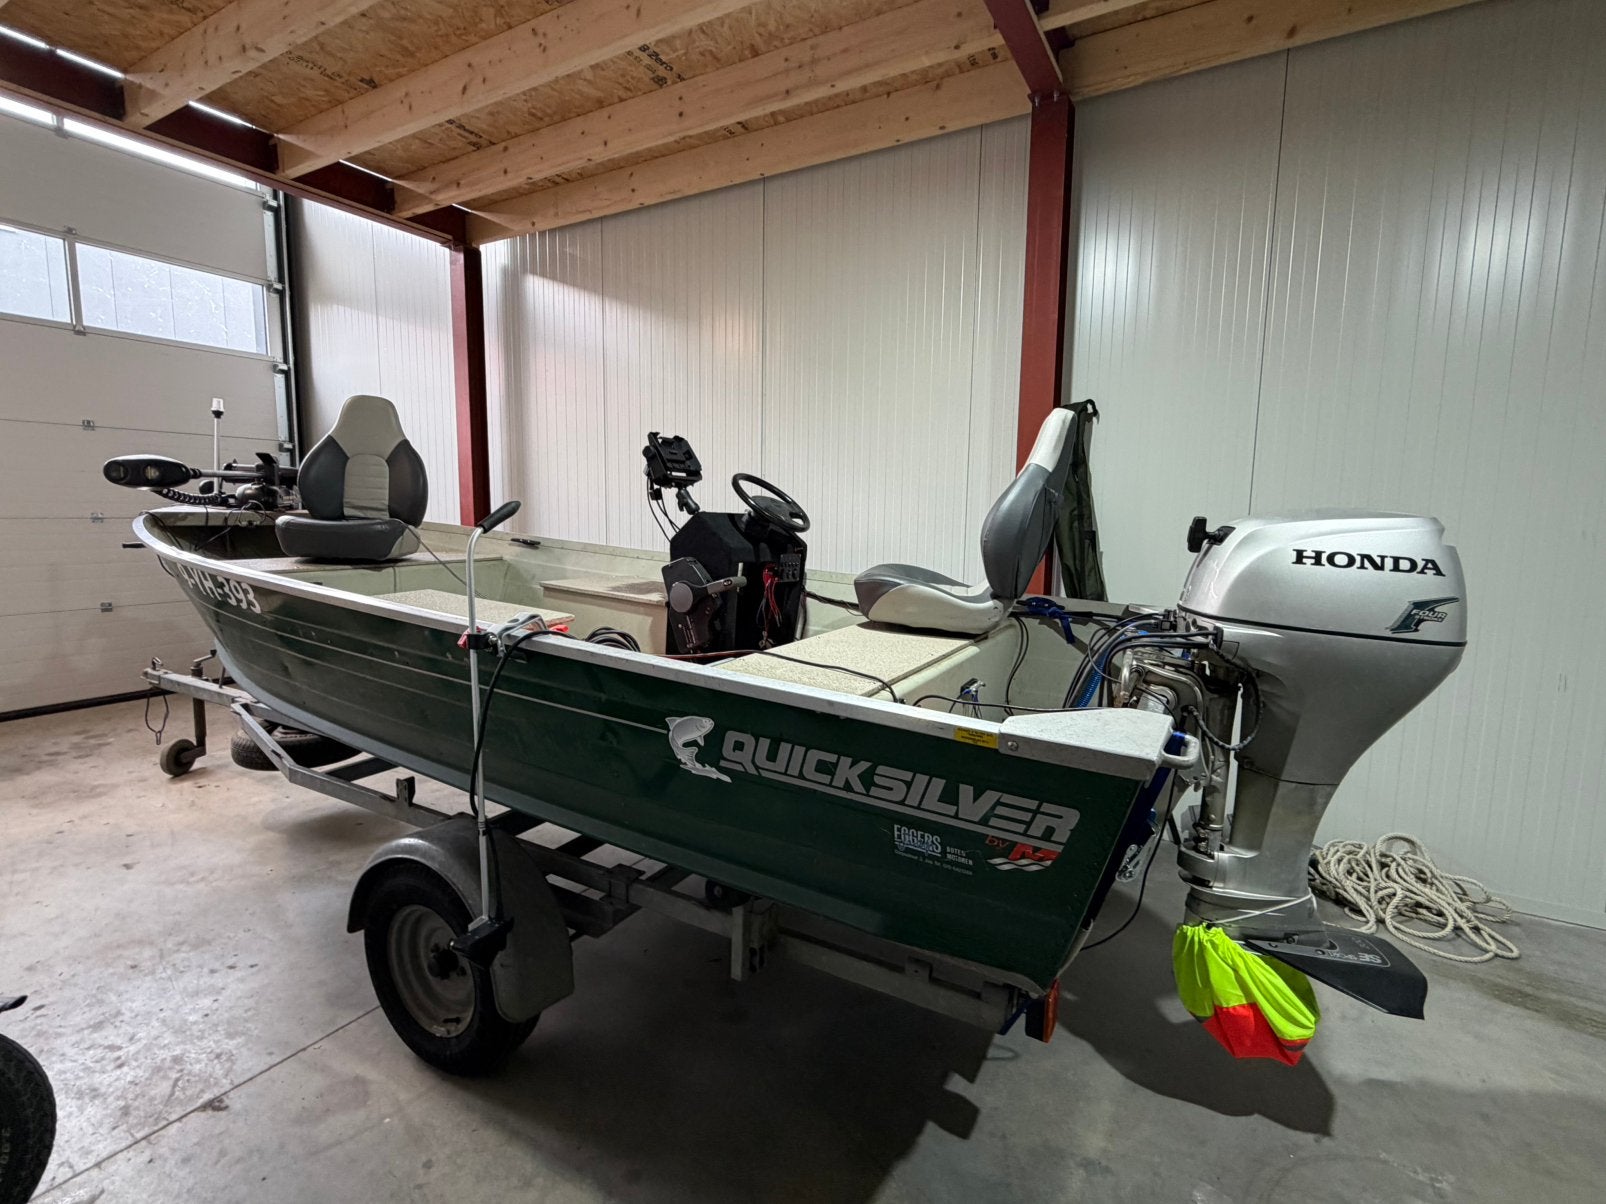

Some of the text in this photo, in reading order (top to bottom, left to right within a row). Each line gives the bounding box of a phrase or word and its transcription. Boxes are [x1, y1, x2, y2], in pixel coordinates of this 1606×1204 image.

[1291, 549, 1446, 577] HONDA
[1410, 609, 1447, 619] FOUR
[720, 730, 1080, 844] QUICKSILVER
[893, 824, 942, 853] EGGERS
[985, 834, 1009, 849] by
